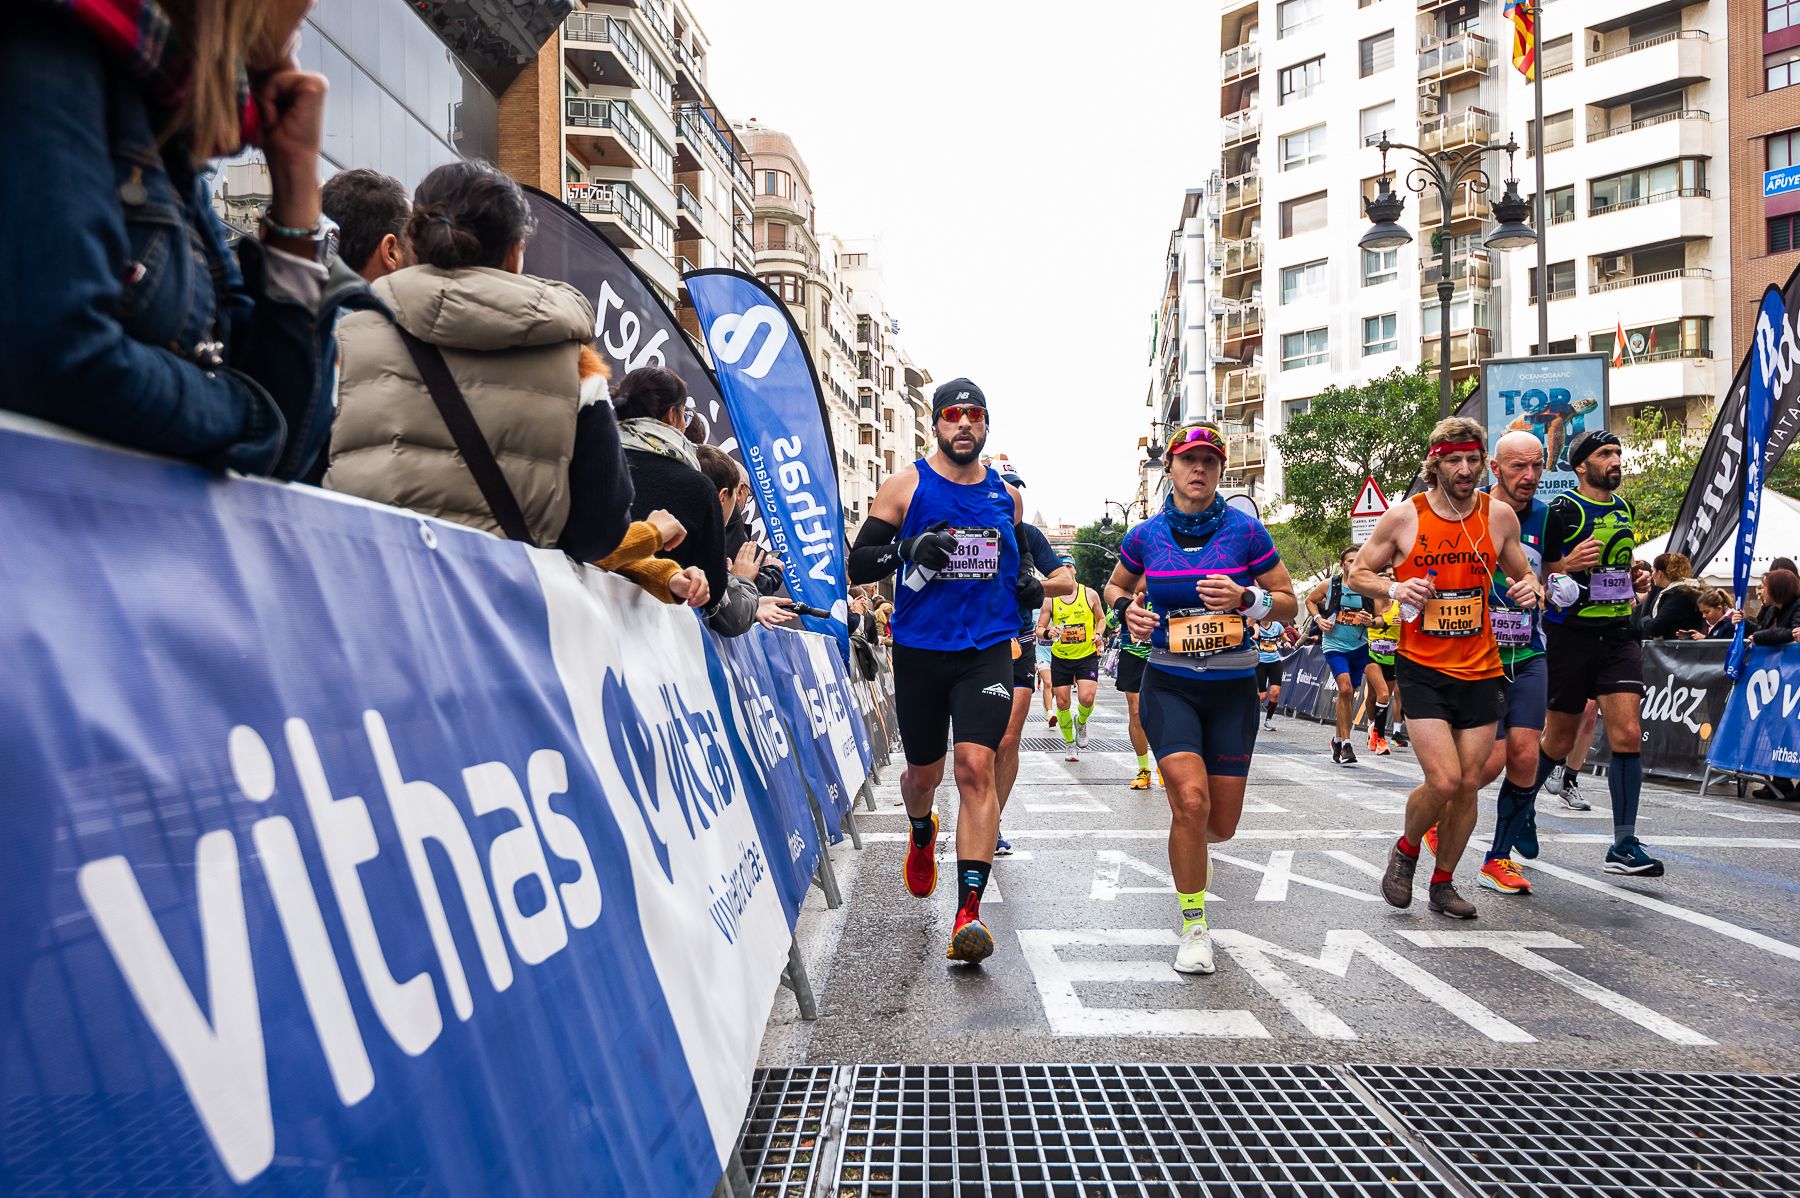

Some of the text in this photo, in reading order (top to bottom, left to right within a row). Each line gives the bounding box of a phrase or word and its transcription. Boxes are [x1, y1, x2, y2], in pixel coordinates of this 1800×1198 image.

[1537, 480, 1576, 489] CUBRE
[944, 558, 996, 571] gueMatti
[1440, 604, 1471, 616] 11191
[1186, 621, 1225, 636] 11951
[1438, 618, 1473, 630] Victor
[1491, 619, 1521, 629] 19575
[1182, 636, 1230, 651] MABEL
[78, 710, 602, 1185] vithas
[1016, 929, 1718, 1045] EMT
